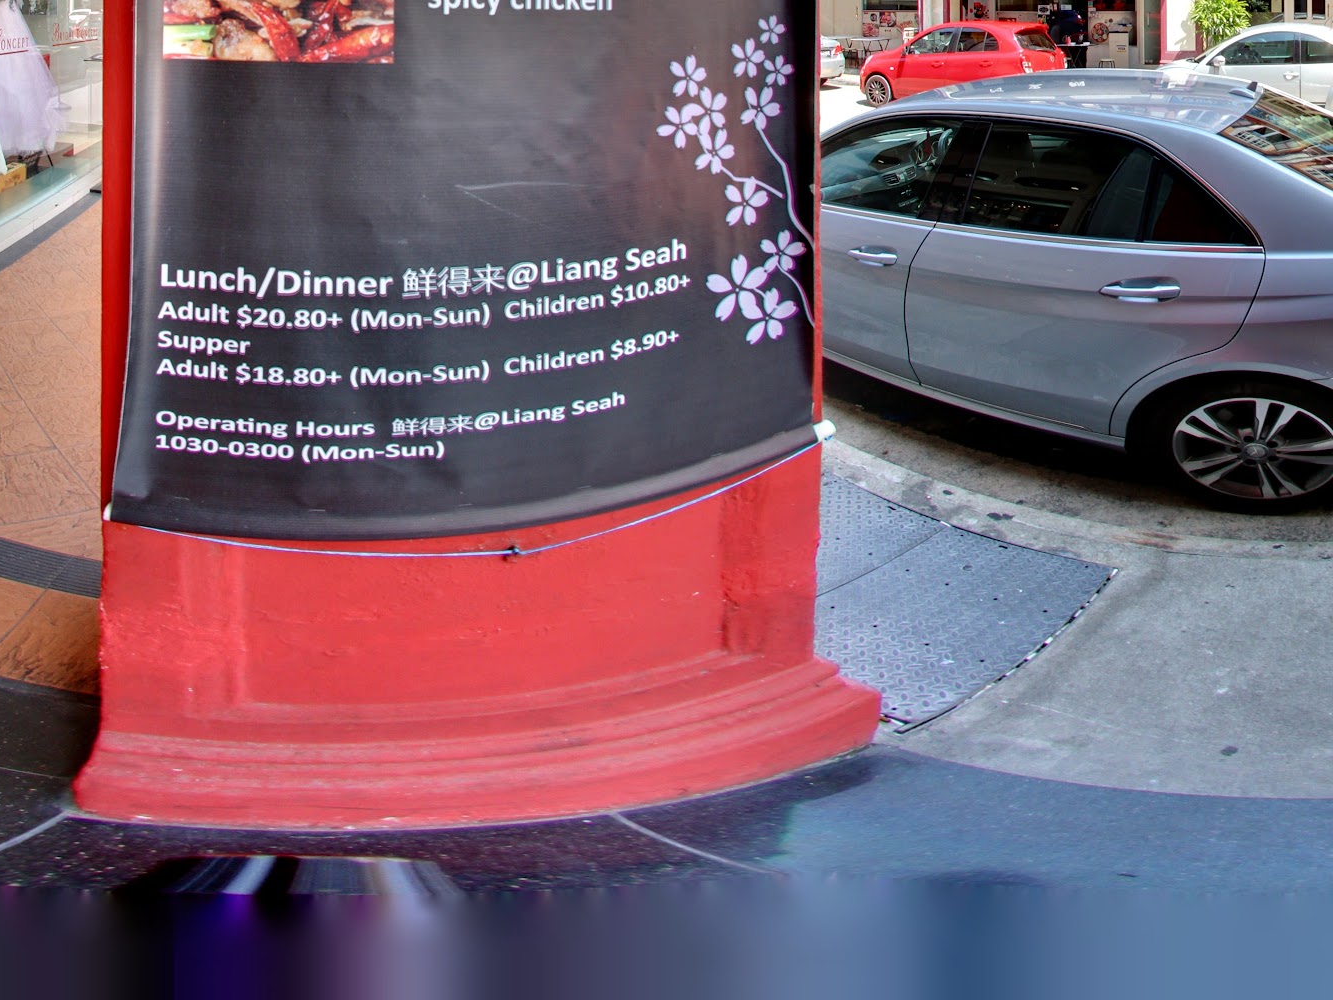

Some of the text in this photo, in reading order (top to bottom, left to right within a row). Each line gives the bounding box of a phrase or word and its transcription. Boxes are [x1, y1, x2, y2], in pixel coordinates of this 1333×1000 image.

[159, 262, 393, 298] Lunch/Dinner
[625, 238, 687, 270] Seah
[157, 273, 691, 334] Adult $20.80+ (Mon-Sun) Children $10.80+
[156, 329, 681, 390] Adult $18.80+ (Mon-Sun) Children $8.90+
[157, 330, 250, 357] Supper
[155, 410, 288, 439] Operating
[295, 418, 376, 437] Hours
[571, 390, 627, 416] Seah
[155, 434, 446, 463] 1030-0300 (Mon-Sun)
